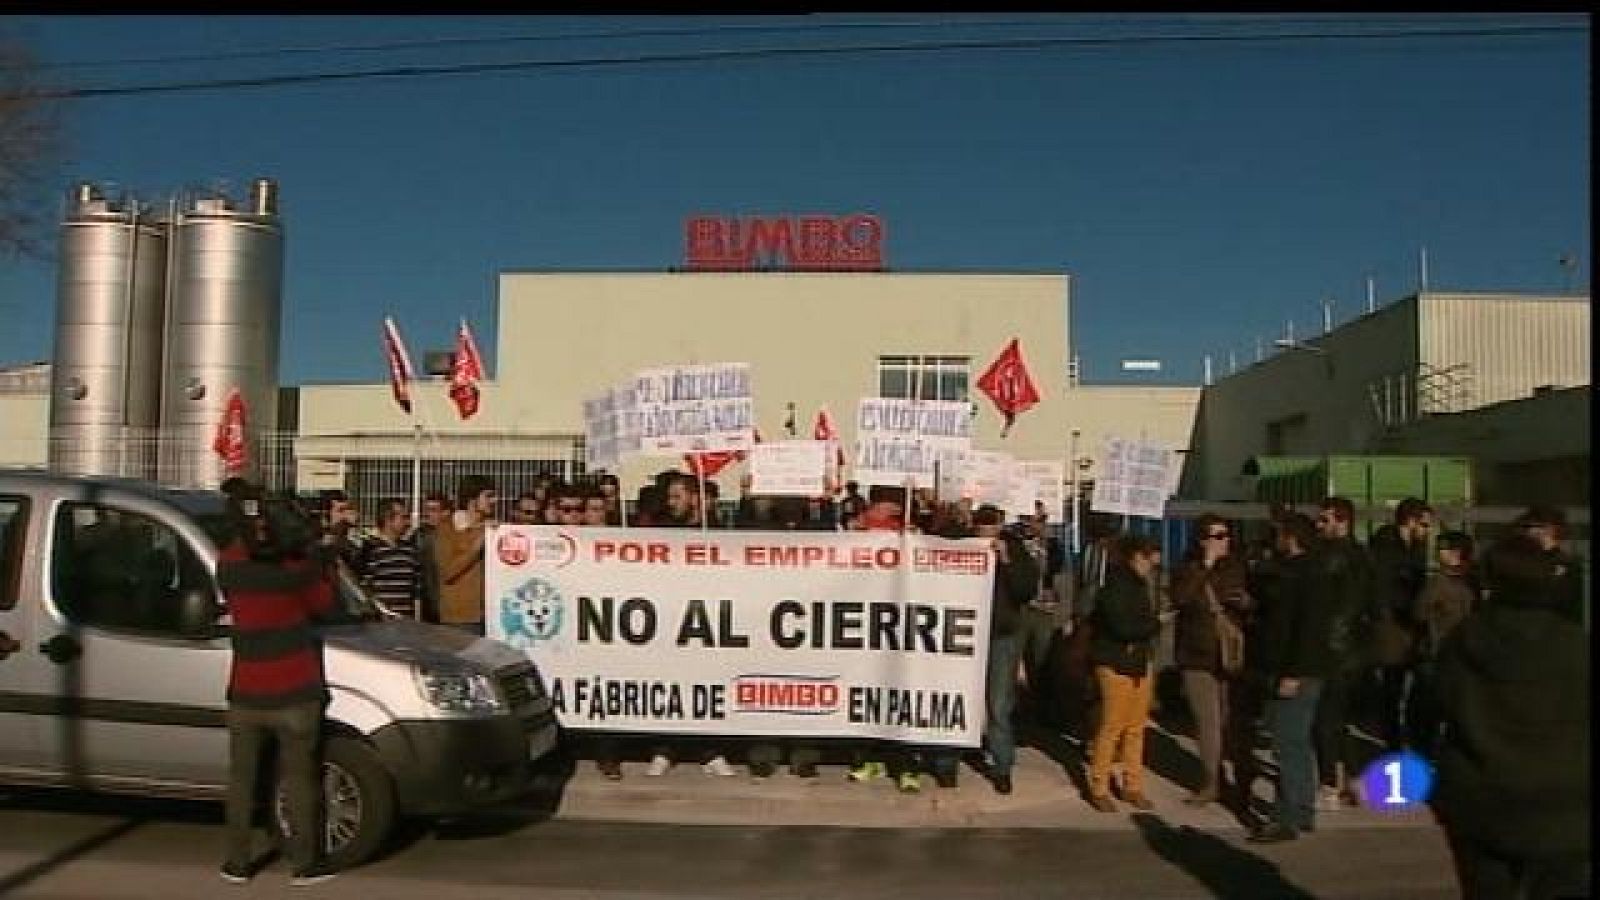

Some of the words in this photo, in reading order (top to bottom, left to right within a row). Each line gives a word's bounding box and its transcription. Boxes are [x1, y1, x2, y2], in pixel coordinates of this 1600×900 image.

[684, 214, 882, 267] BIMBO
[593, 540, 670, 564] POR
[684, 543, 730, 567] EL
[744, 545, 901, 570] EMPLEO
[577, 597, 657, 645] NO
[677, 599, 749, 648] AL
[770, 600, 976, 656] CIERRE
[574, 675, 686, 720] FÁBRICA
[692, 684, 726, 720] DE
[737, 681, 838, 707] BIMBO
[848, 687, 880, 724] EN
[887, 688, 967, 732] PALMA
